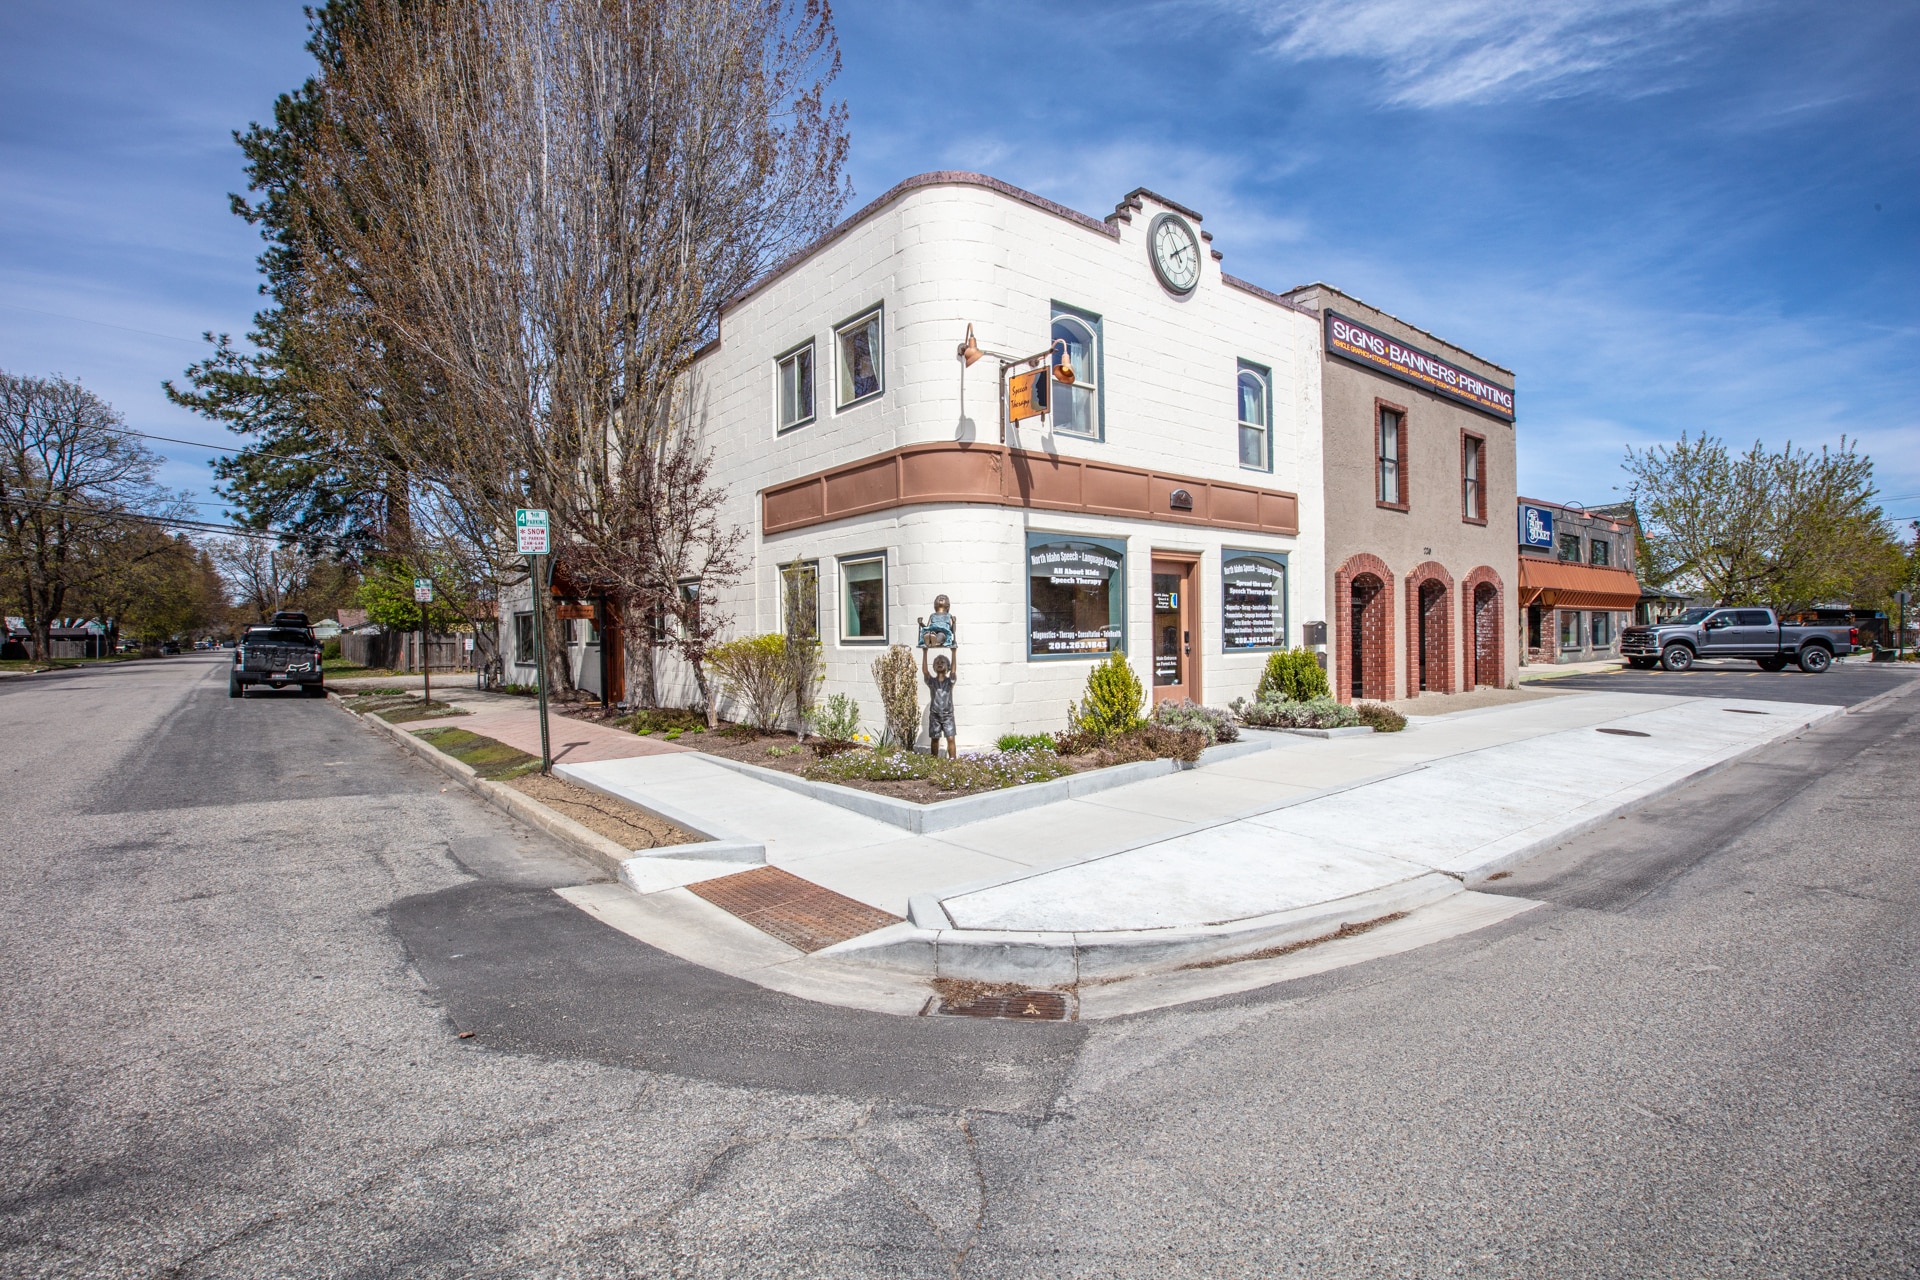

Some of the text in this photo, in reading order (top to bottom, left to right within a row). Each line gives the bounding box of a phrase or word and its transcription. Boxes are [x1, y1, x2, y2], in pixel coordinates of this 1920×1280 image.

[1332, 338, 1350, 351] VEHICLE
[1333, 321, 1512, 408] SIGNS BANNERS PRINTING
[1012, 382, 1028, 397] Speech
[518, 512, 526, 524] 4
[1031, 553, 1046, 565] North
[1046, 551, 1061, 563] Idaho
[1060, 551, 1079, 563] Speech
[1081, 552, 1104, 566] Language
[1053, 567, 1064, 575] All
[1085, 568, 1100, 576] Kids
[1050, 576, 1103, 586] Speech Therapy
[1229, 587, 1246, 595] Speech
[1246, 588, 1265, 596] Therapy
[1059, 630, 1075, 640] Therapy
